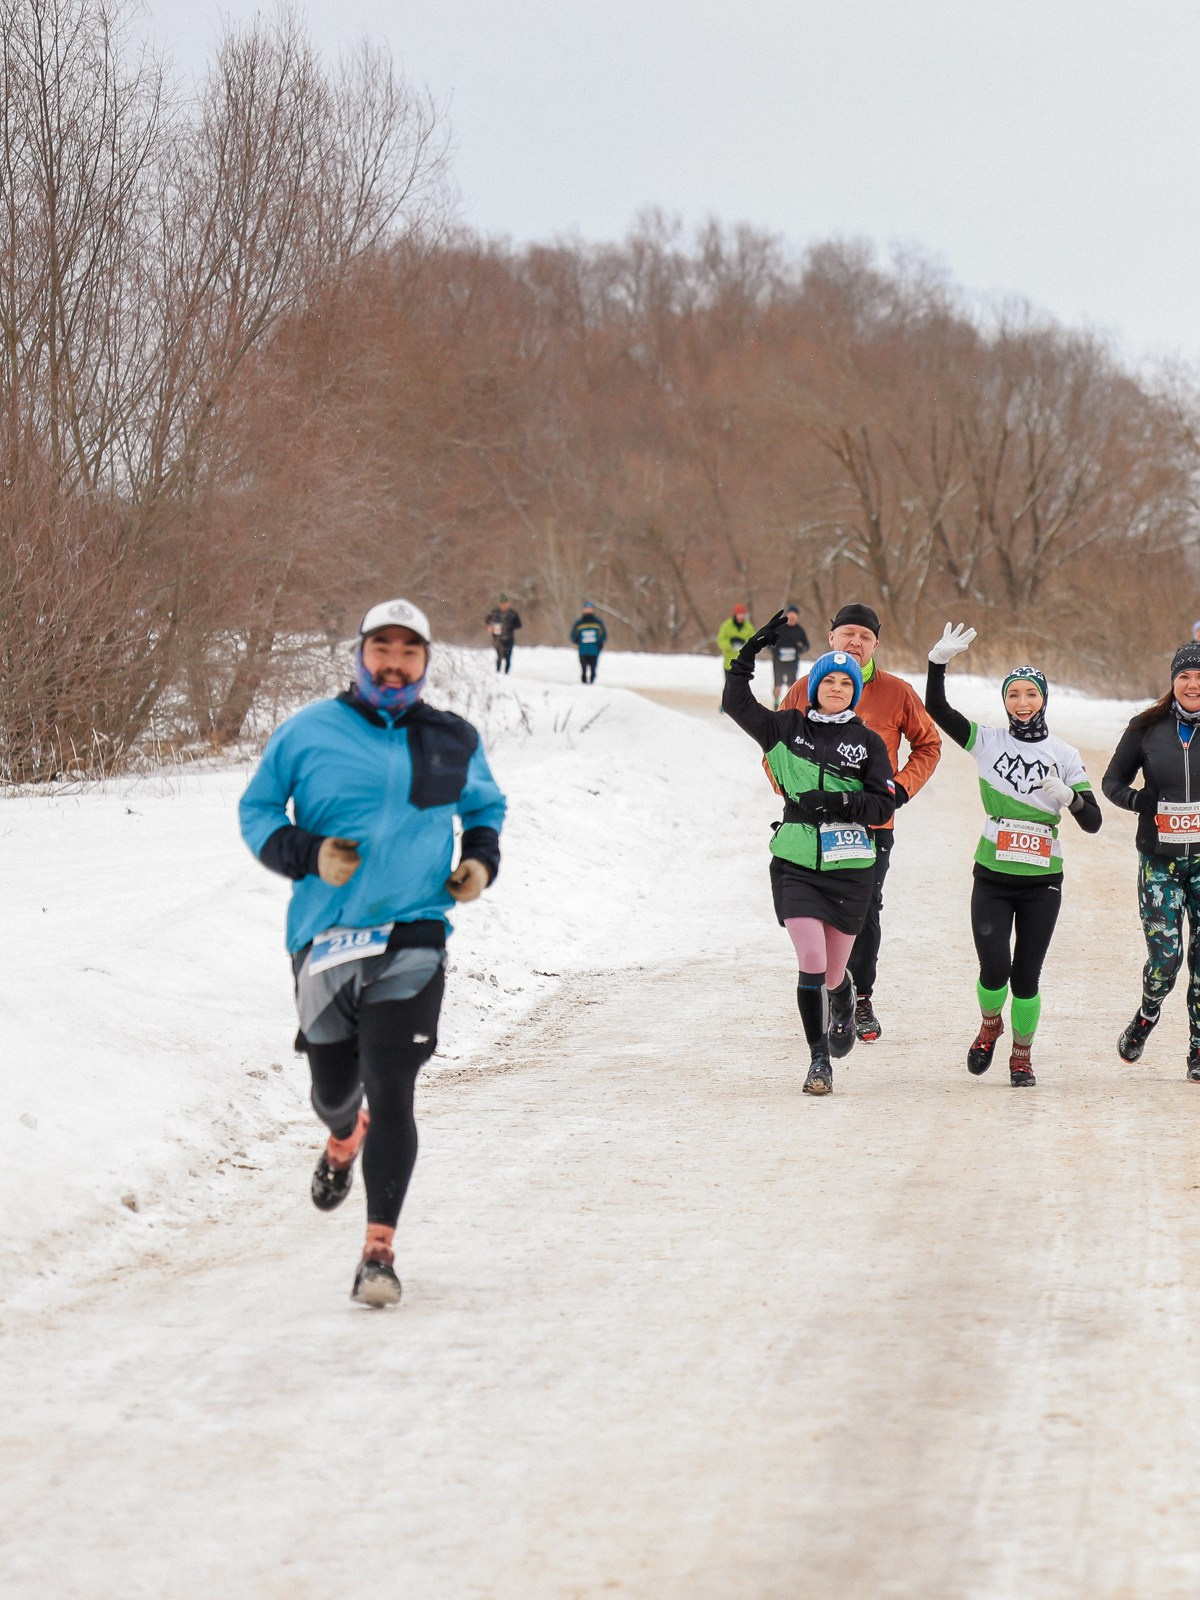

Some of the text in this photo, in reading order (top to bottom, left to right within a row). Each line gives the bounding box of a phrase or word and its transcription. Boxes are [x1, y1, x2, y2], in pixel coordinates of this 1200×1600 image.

[834, 830, 863, 846] 192
[1009, 833, 1041, 851] 108
[327, 930, 372, 955] 218
